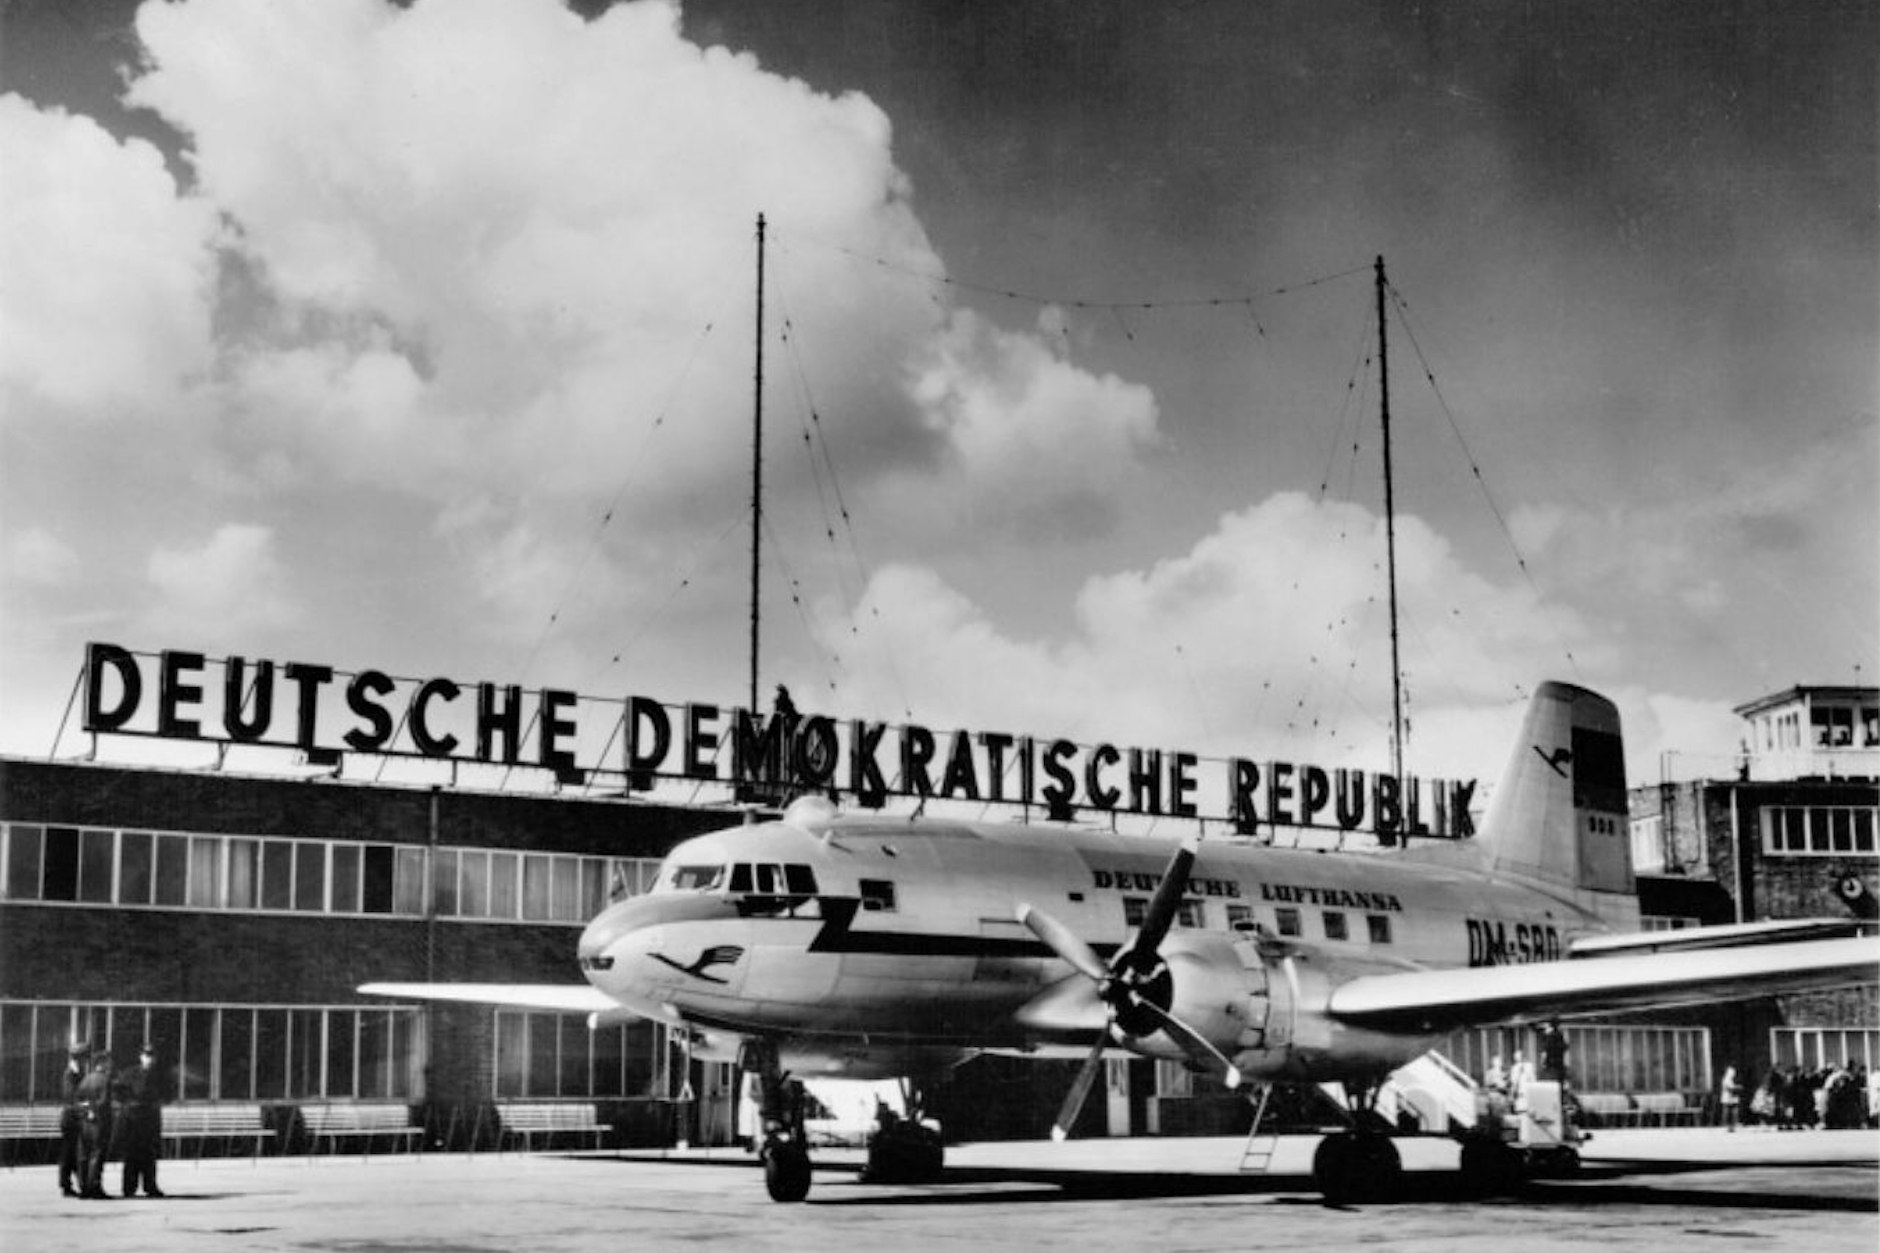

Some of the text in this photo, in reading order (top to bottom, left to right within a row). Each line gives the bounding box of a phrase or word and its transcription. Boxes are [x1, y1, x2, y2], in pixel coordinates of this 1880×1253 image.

[84, 642, 1477, 839] DEUTSCHE DEMOKRATISCHE REPUBLIK
[1093, 870, 1403, 912] DEUCHE LUFTHANSA
